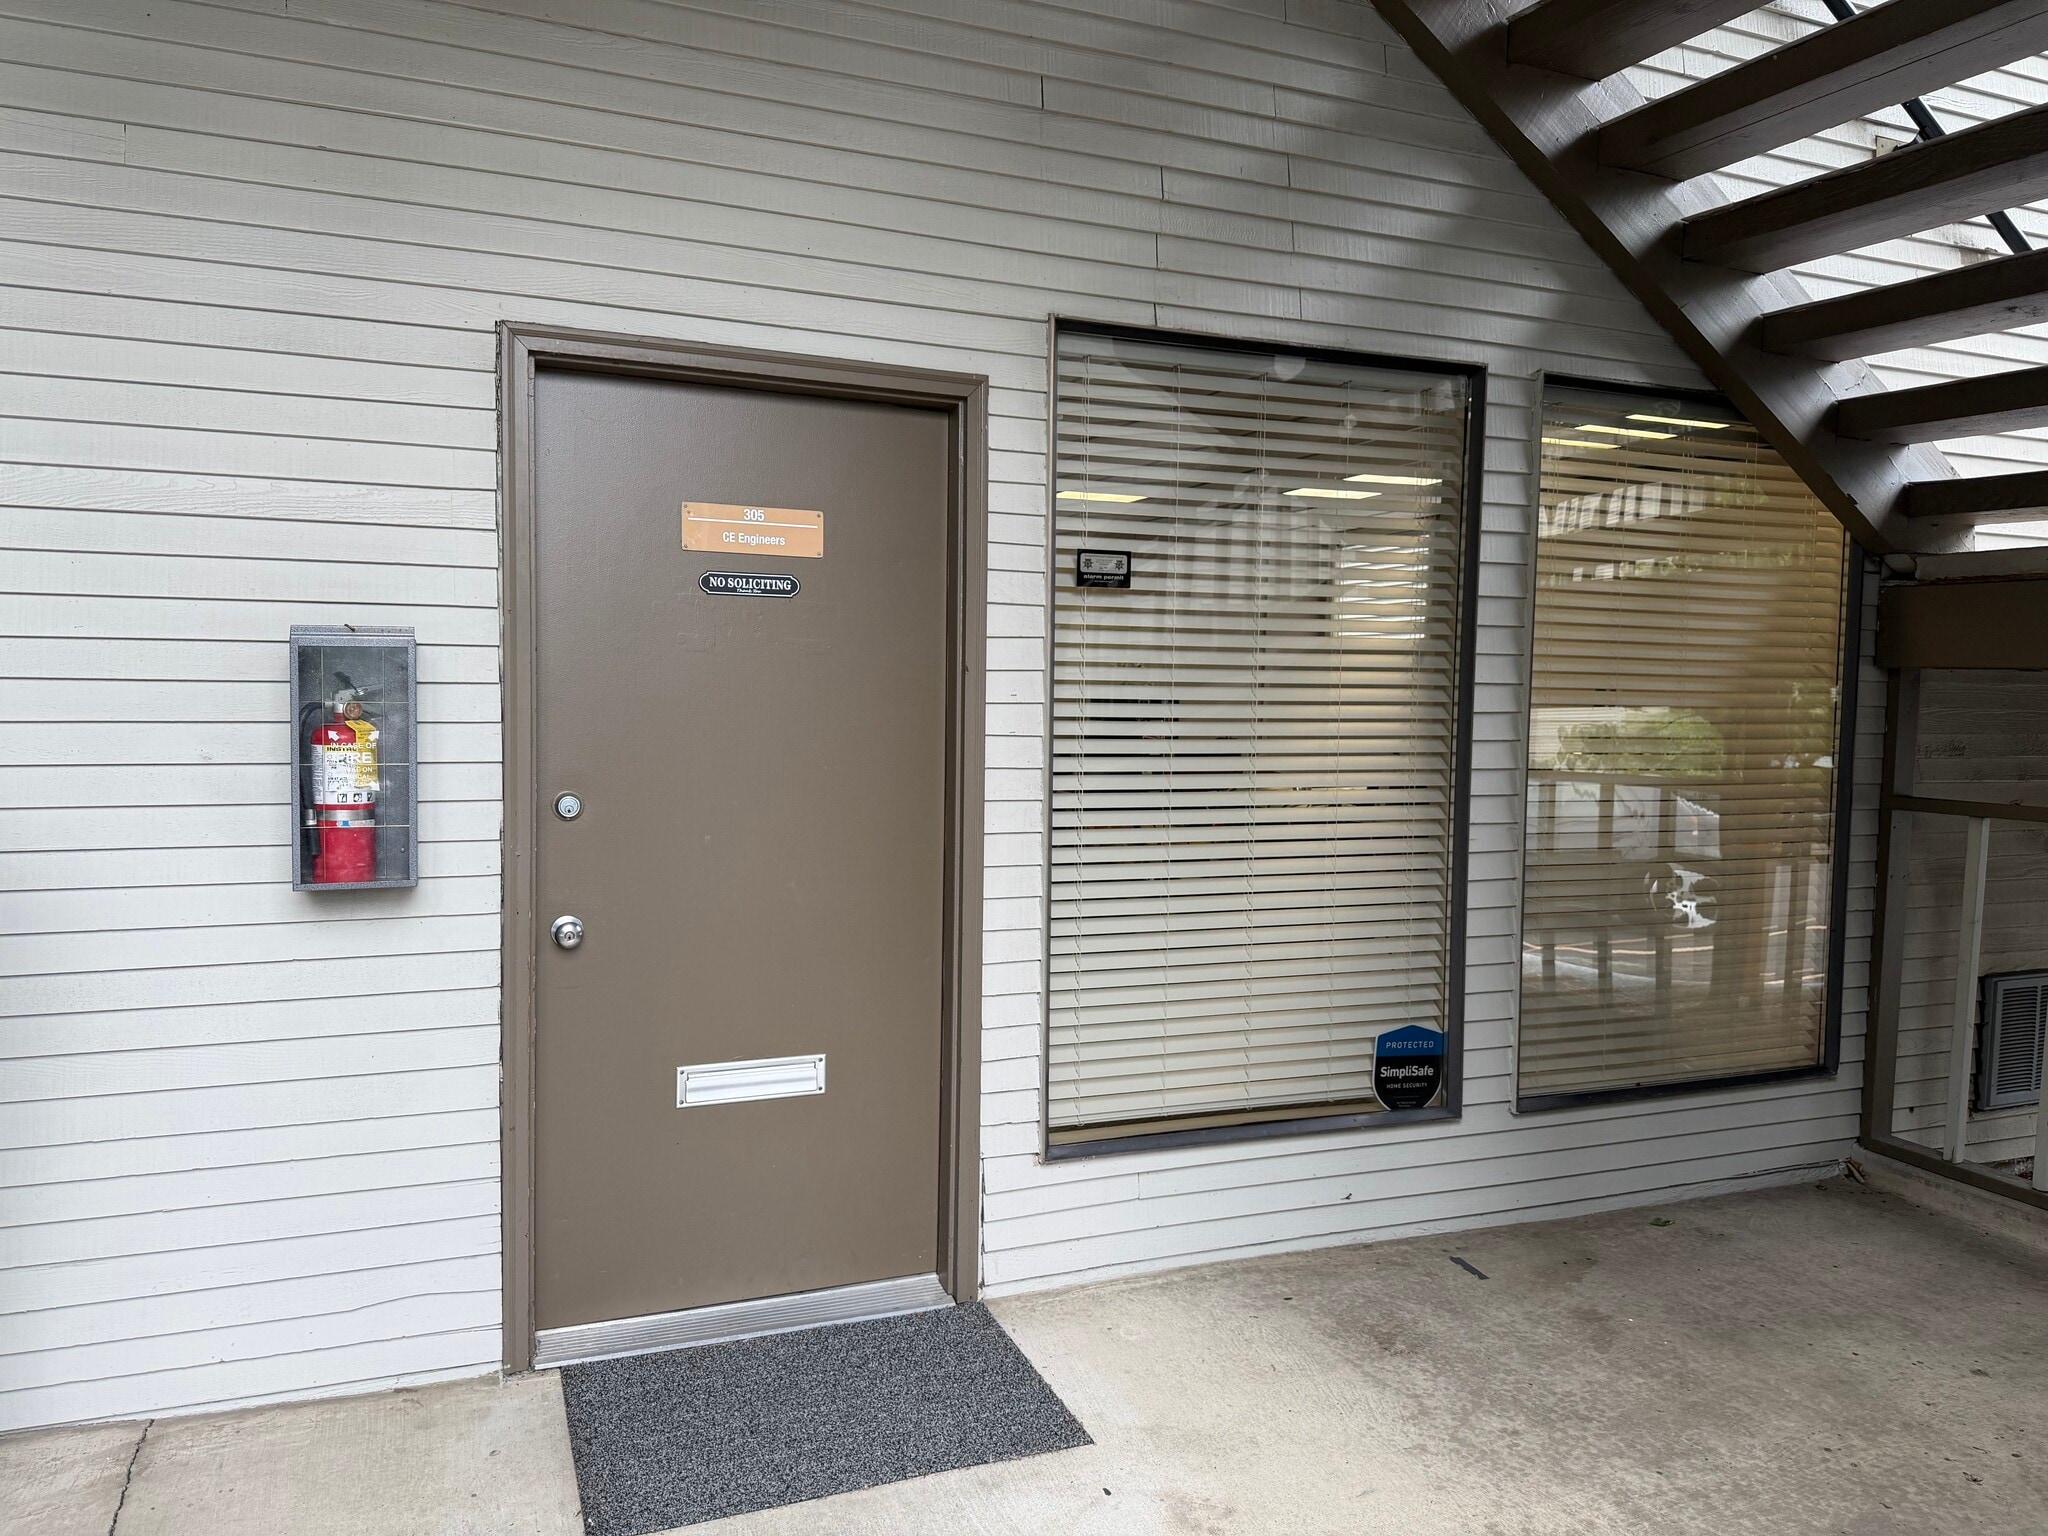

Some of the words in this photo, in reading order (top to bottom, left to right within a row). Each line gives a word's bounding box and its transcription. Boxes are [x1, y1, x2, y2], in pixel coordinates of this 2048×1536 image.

[743, 508, 765, 522] 305
[722, 531, 736, 543] CE
[738, 532, 786, 546] Engineers
[709, 576, 726, 588] NO
[727, 577, 792, 591] SOLICITING
[1385, 1040, 1435, 1049] PROTECTED
[1380, 1065, 1434, 1079] SimpliSafe
